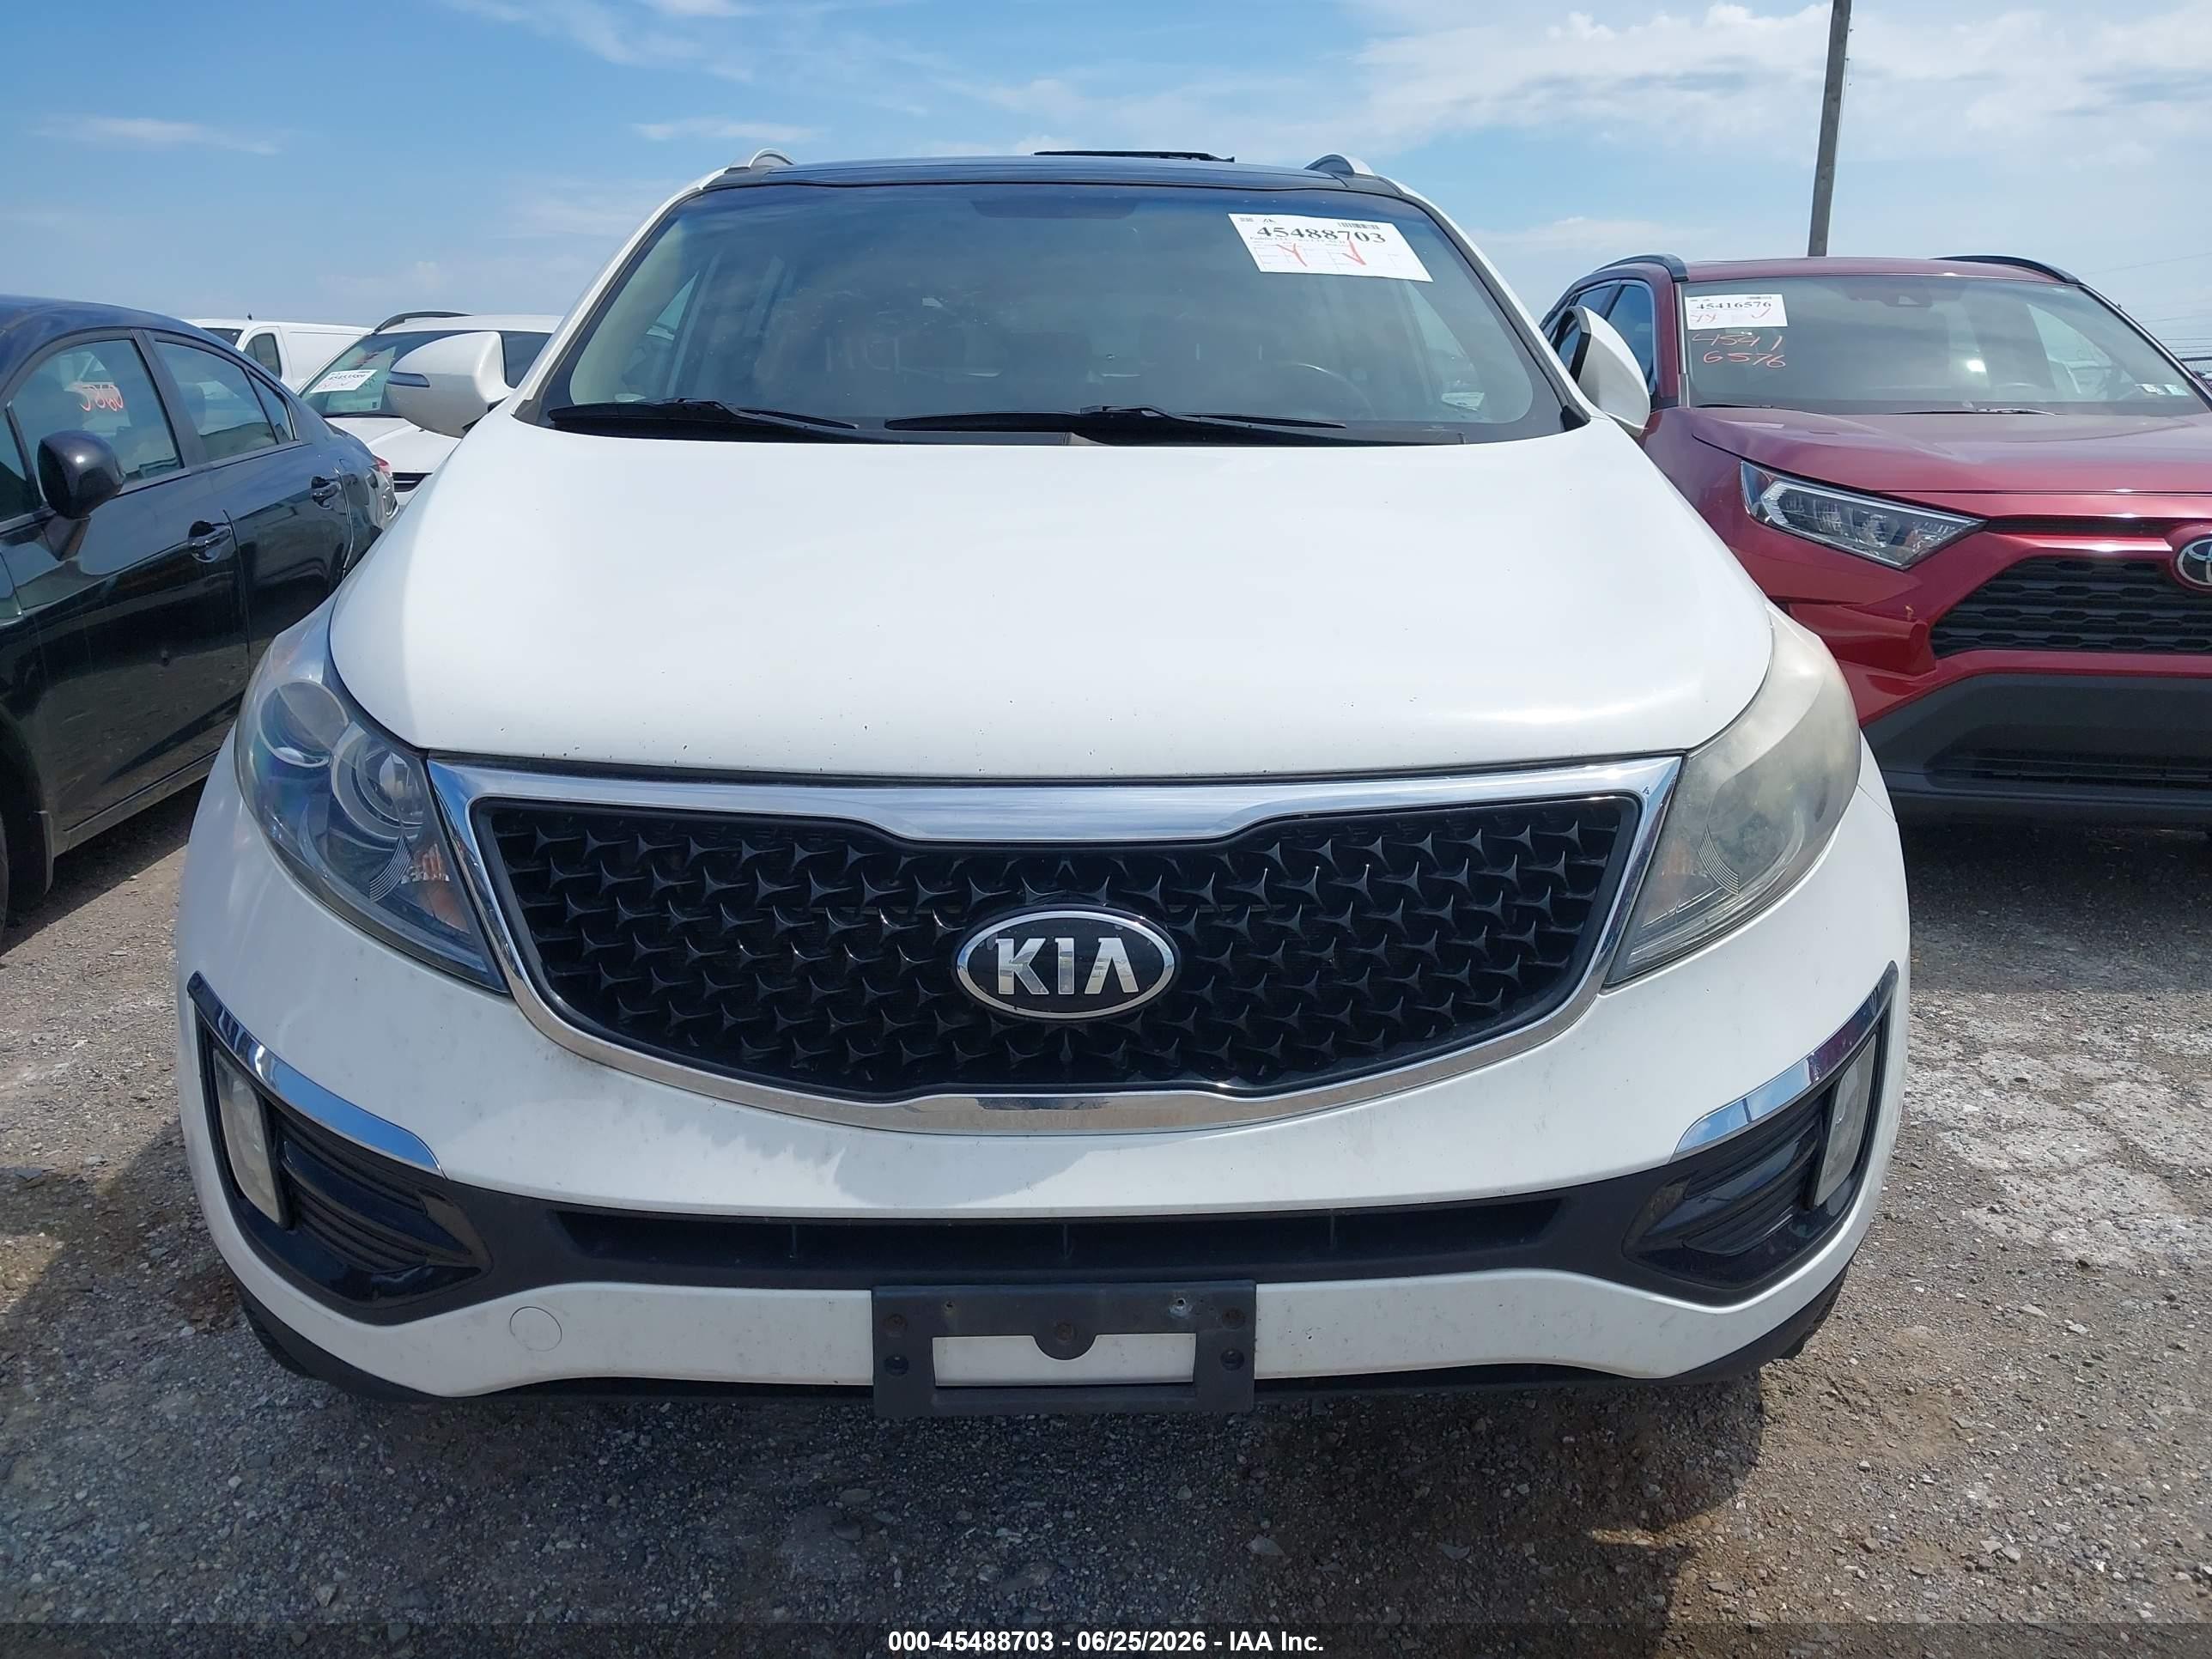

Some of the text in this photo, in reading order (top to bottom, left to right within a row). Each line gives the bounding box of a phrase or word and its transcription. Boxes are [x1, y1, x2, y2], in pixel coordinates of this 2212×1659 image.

[1256, 227, 1387, 244] 45488703
[1696, 301, 1772, 310] 45416576
[1703, 350, 1786, 368] 6576
[995, 938, 1139, 995] KIA
